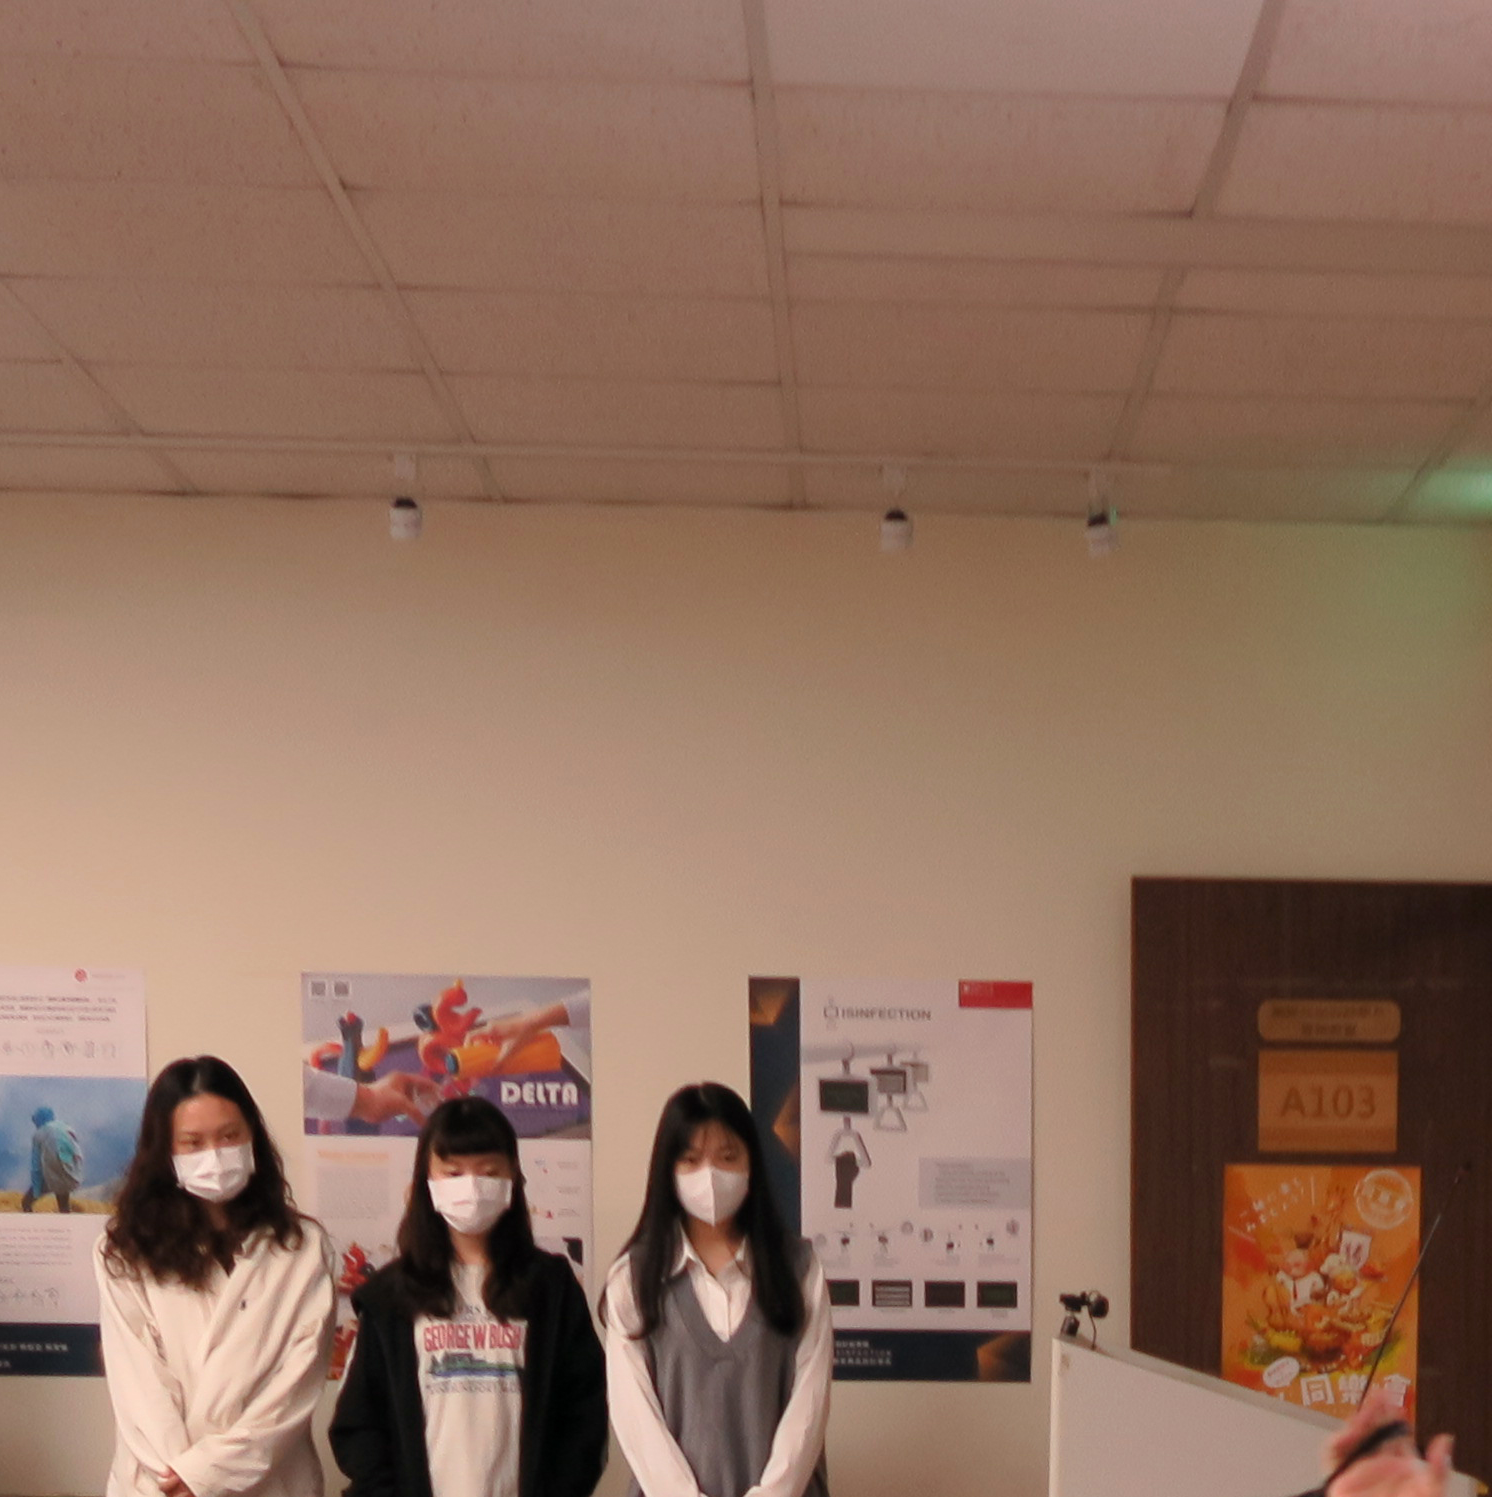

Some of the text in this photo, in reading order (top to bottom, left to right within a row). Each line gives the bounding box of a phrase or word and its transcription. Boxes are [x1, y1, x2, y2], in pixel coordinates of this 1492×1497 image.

[499, 1080, 579, 1106] DELTA
[1280, 1085, 1376, 1120] A103
[1278, 1372, 1411, 1406] 同樂會
